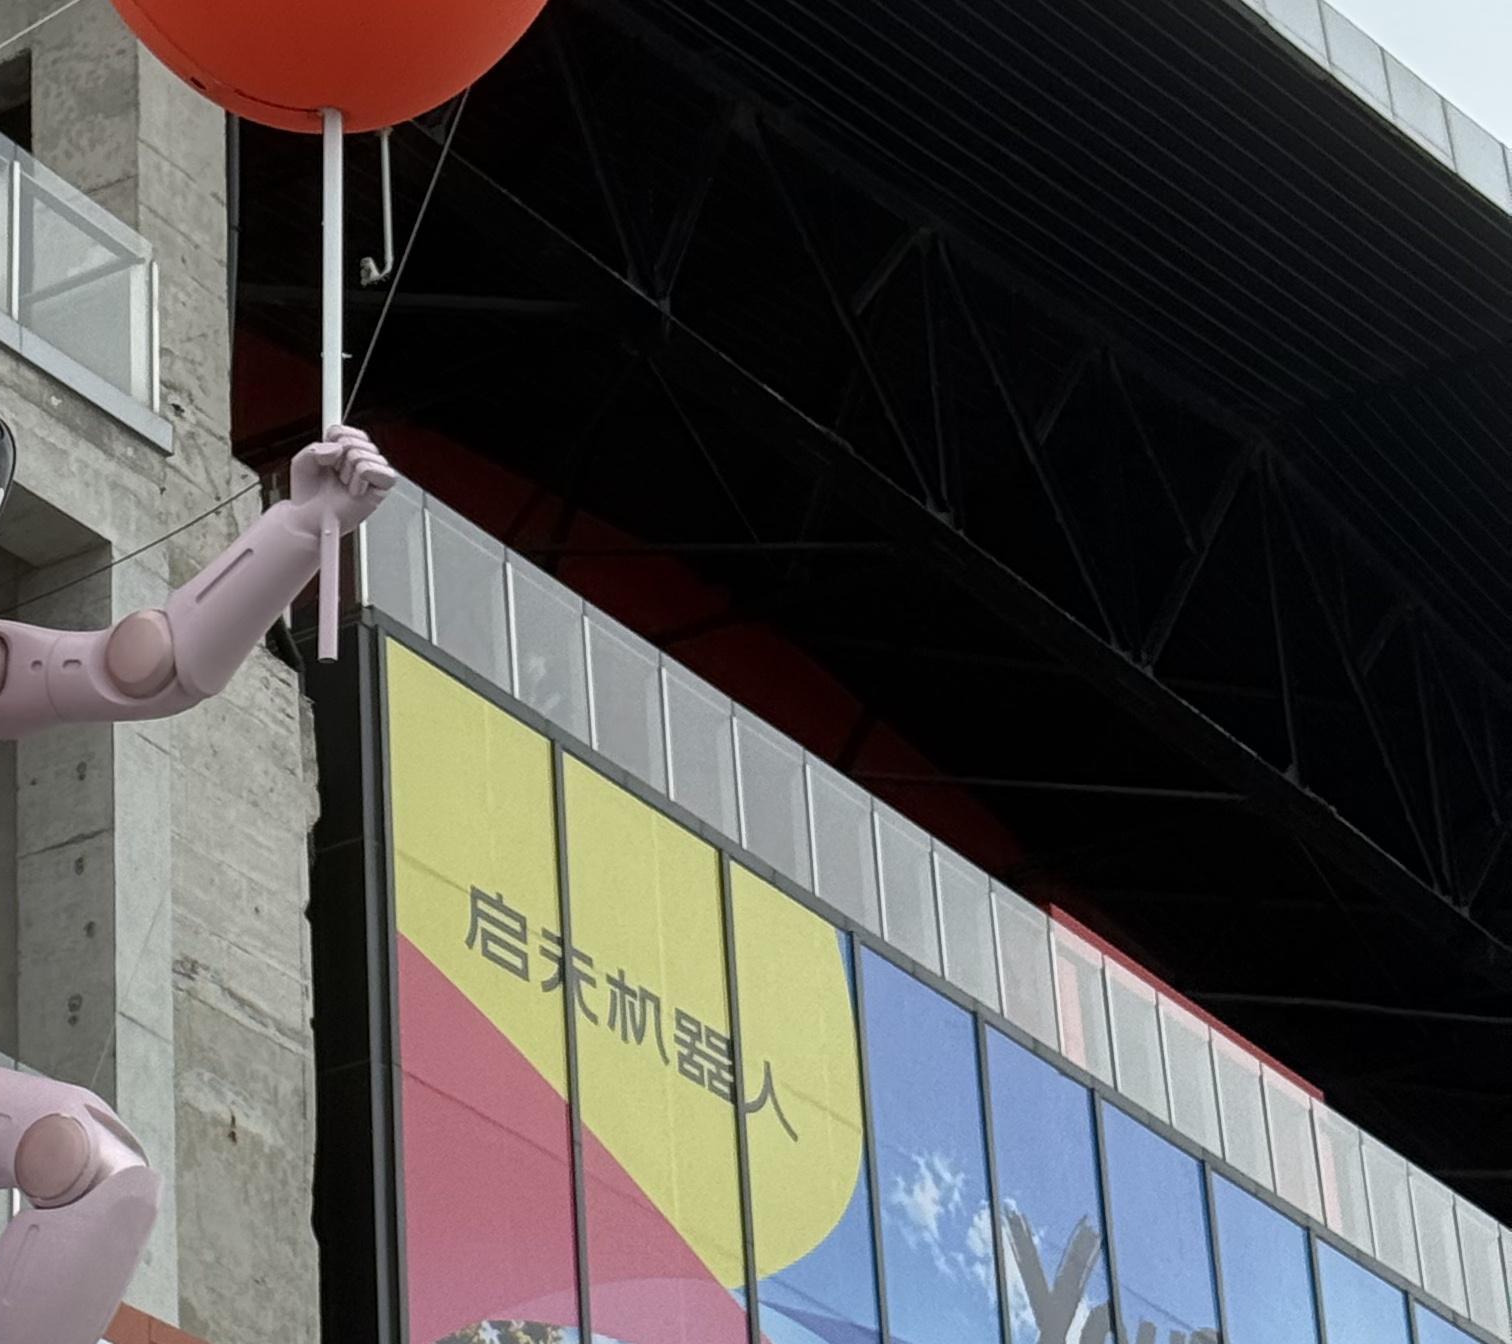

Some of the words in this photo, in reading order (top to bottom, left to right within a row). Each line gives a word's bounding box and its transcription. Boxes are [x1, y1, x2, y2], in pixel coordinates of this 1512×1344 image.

[465, 885, 798, 1142] 启元机器人
